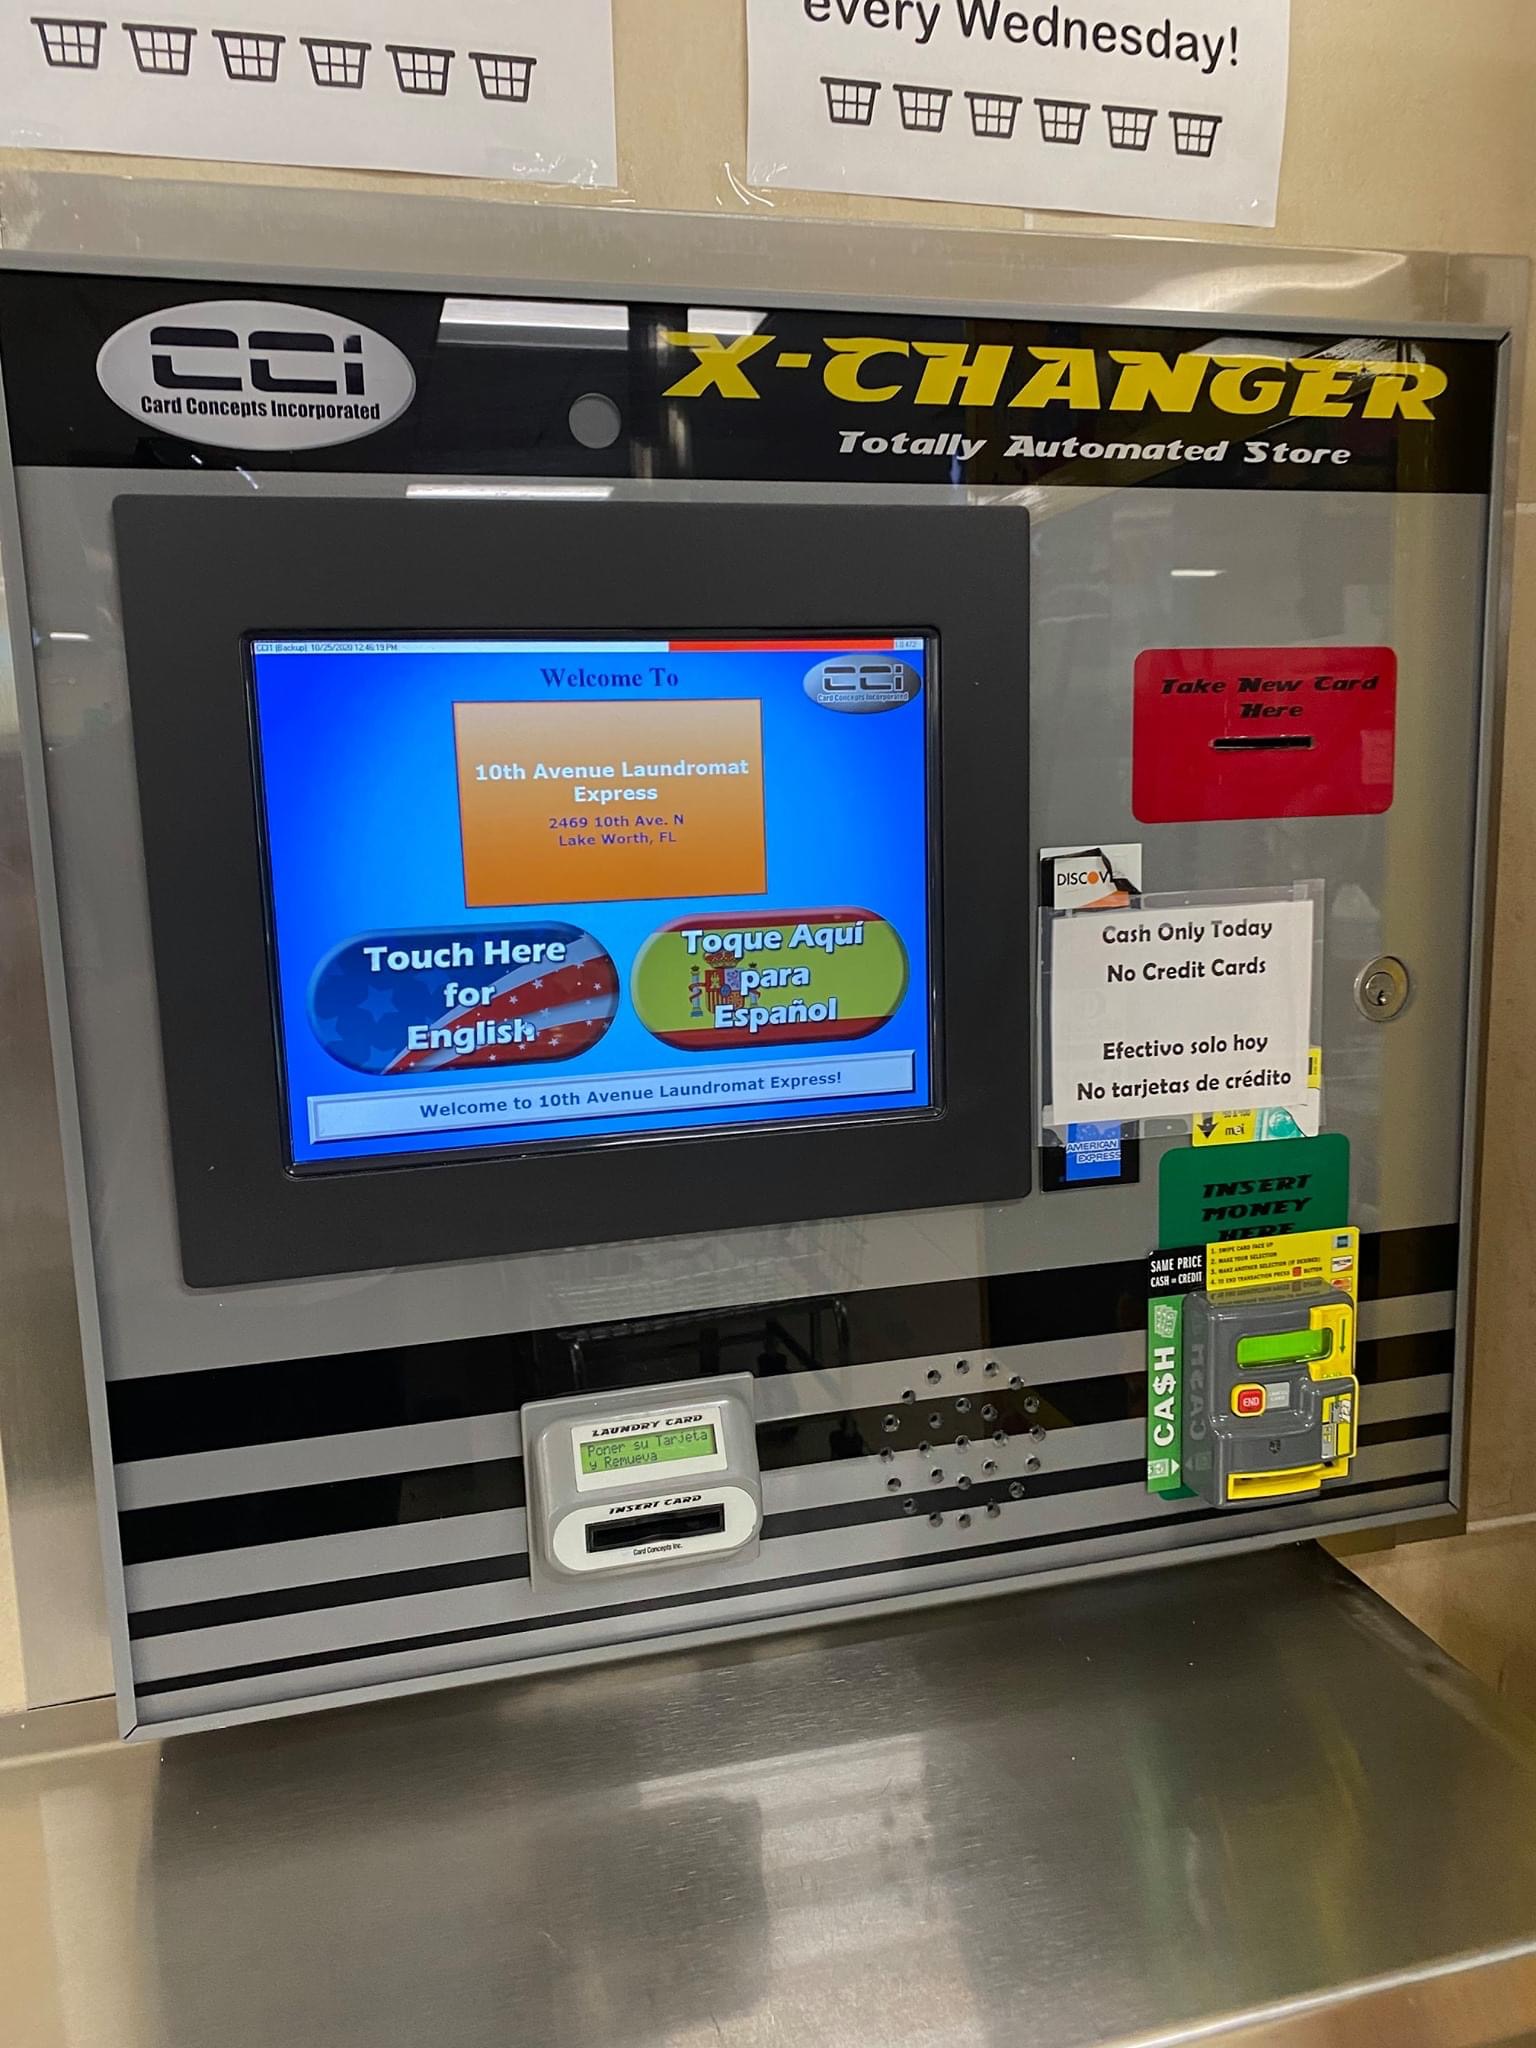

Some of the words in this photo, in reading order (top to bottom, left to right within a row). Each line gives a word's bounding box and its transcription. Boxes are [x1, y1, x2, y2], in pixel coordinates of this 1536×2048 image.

[803, 0, 940, 45] every
[956, 0, 1239, 75] Wednesday!
[660, 331, 1448, 420] X-CHANGER
[141, 395, 182, 415] Card
[186, 397, 267, 418] Concepts
[271, 400, 381, 420] Incorporated
[838, 430, 987, 461] Totally
[1003, 434, 1230, 462] Automated
[1243, 441, 1352, 465] Store
[539, 667, 643, 688] Welcome
[649, 667, 679, 687] To
[1160, 678, 1227, 695] Take
[1237, 677, 1303, 692] New
[1314, 675, 1380, 691] Card
[818, 693, 834, 702] Card
[834, 693, 865, 703] Concepts
[865, 692, 909, 702] Incorporated
[1239, 703, 1304, 718] Here
[475, 762, 526, 781] 10th
[532, 761, 615, 780] Avenue
[621, 759, 749, 778] Laundromat
[574, 785, 658, 805] Express
[549, 816, 588, 829] 2469
[595, 815, 629, 828] 10th
[635, 815, 668, 827] Ave.
[674, 813, 684, 826] N
[559, 833, 596, 847] Lake
[601, 831, 654, 847] Worth,
[659, 831, 676, 843] FL
[680, 928, 783, 960] Toque
[788, 920, 865, 953] Aquí
[1102, 924, 1151, 945] Cash
[1158, 921, 1205, 943] Only
[1210, 918, 1273, 939] Today
[363, 942, 474, 972] Touch
[484, 940, 566, 965] Here
[1107, 964, 1136, 983] No
[1142, 961, 1206, 981] Credit
[1211, 957, 1267, 977] Cards
[740, 966, 811, 997] para
[443, 982, 496, 1008] for
[713, 997, 839, 1033] Español
[407, 1018, 536, 1055] English
[1103, 1038, 1184, 1061] Efectivo
[1190, 1036, 1228, 1055] solo
[1234, 1034, 1269, 1053] hoy
[420, 1098, 508, 1119] Welcome
[513, 1096, 532, 1110] to
[539, 1092, 581, 1108] 10th
[586, 1087, 654, 1104] Avenue
[659, 1077, 765, 1098] Laundromat
[770, 1071, 842, 1091] Express!
[1077, 1082, 1106, 1101] No
[1112, 1078, 1190, 1099] tarjetas
[1196, 1074, 1220, 1091] de
[1226, 1068, 1292, 1089] crédito
[1066, 1139, 1118, 1153] AMERICAN
[1077, 1151, 1121, 1163] EXPRESS
[1202, 1174, 1313, 1199] INSERT
[1201, 1197, 1313, 1223] MONEY
[1217, 1222, 1297, 1242] HERE
[1150, 1258, 1175, 1272] SAME
[1177, 1255, 1202, 1269] PRICE
[1234, 1255, 1248, 1263] YOUR
[1250, 1251, 1277, 1260] SELECTION
[1234, 1264, 1258, 1273] ANOTHER
[1259, 1260, 1287, 1269] SELECTION
[1150, 1275, 1170, 1288] CASH
[1178, 1271, 1202, 1284] CREDIT
[1226, 1275, 1237, 1284] END
[1238, 1272, 1272, 1282] TRANSACTION
[1273, 1270, 1290, 1278] PRESS
[1303, 1266, 1323, 1274] BUTTON
[1243, 1396, 1260, 1407] END
[592, 1420, 660, 1437] LAUNDRY
[665, 1414, 703, 1426] CARD
[587, 1442, 625, 1457] Poner
[634, 1439, 649, 1450] su
[656, 1429, 708, 1448] Tarjeta
[589, 1460, 598, 1470] y
[604, 1451, 658, 1468] Remueva
[609, 1500, 661, 1515] INSERT
[664, 1495, 702, 1507] CARD
[633, 1547, 647, 1556] Card
[647, 1543, 672, 1554] Concepts
[672, 1542, 683, 1550] Inc.
